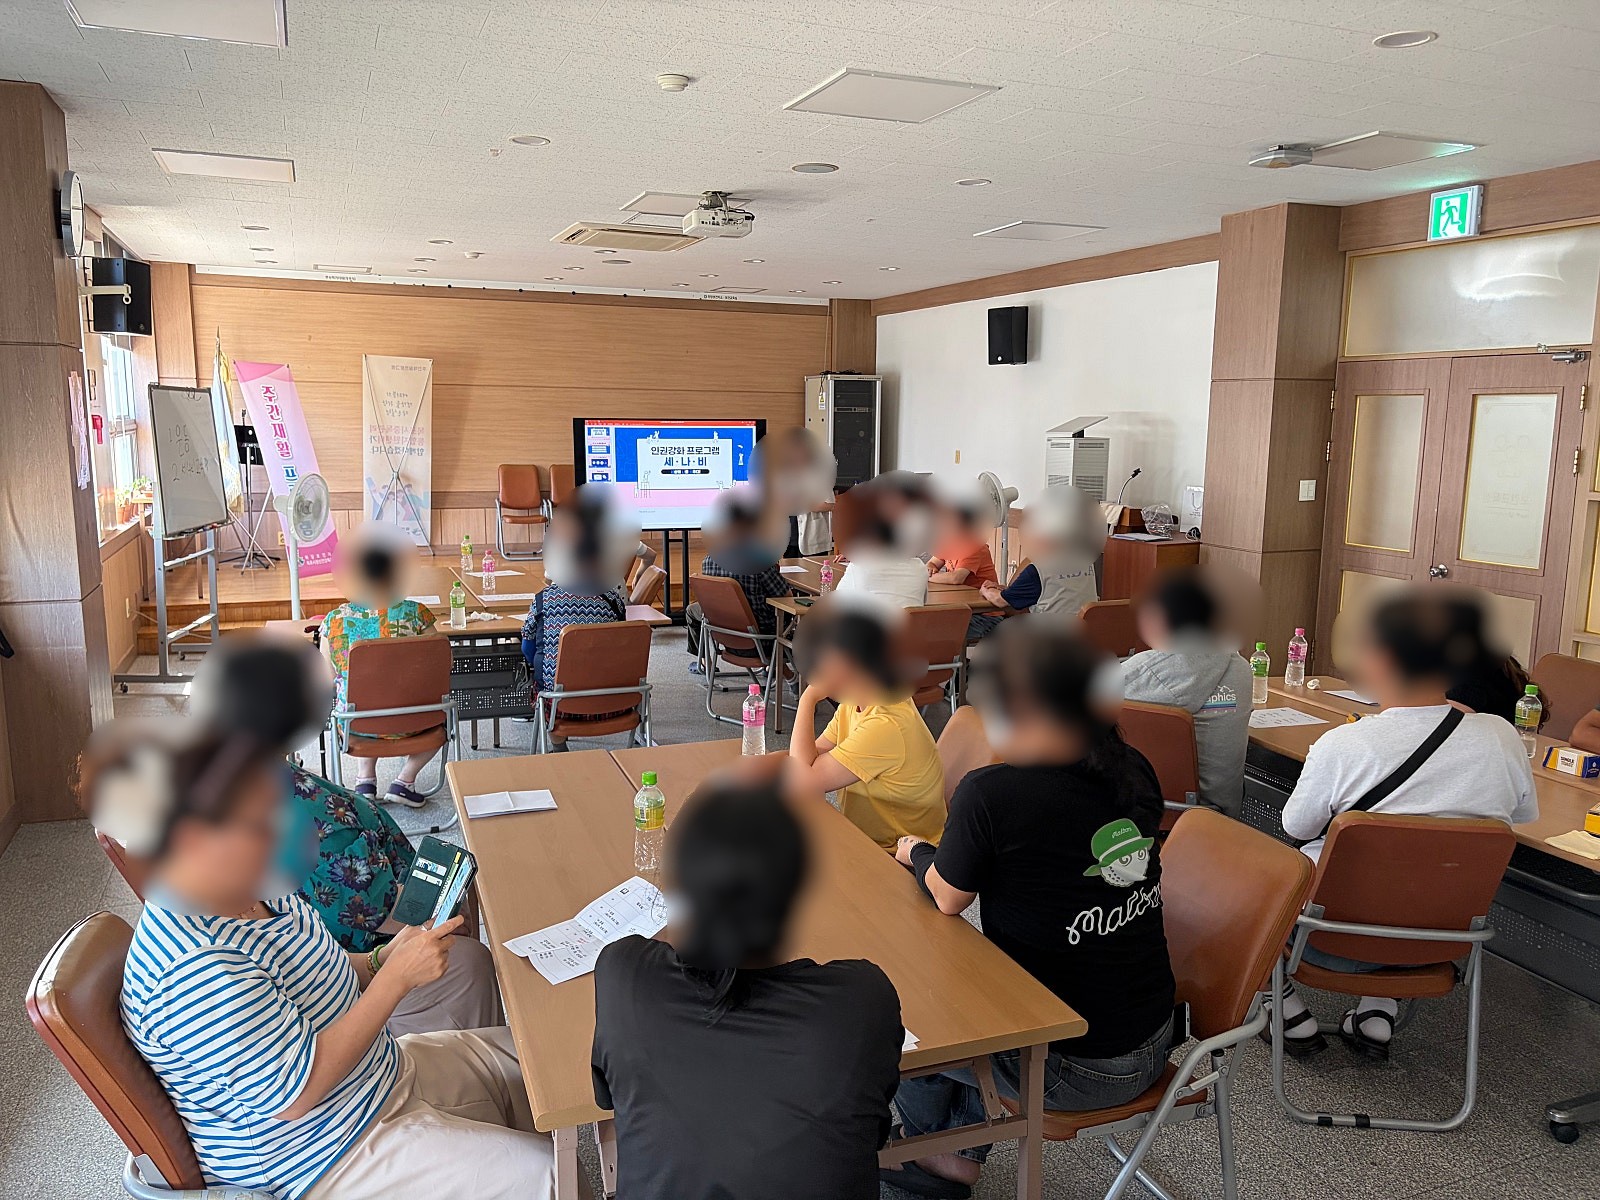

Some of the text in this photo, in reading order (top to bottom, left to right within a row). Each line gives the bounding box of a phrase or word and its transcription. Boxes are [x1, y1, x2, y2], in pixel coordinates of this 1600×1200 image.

[261, 385, 293, 459] 주간재활
[651, 446, 720, 456] 인권강화 프로그램
